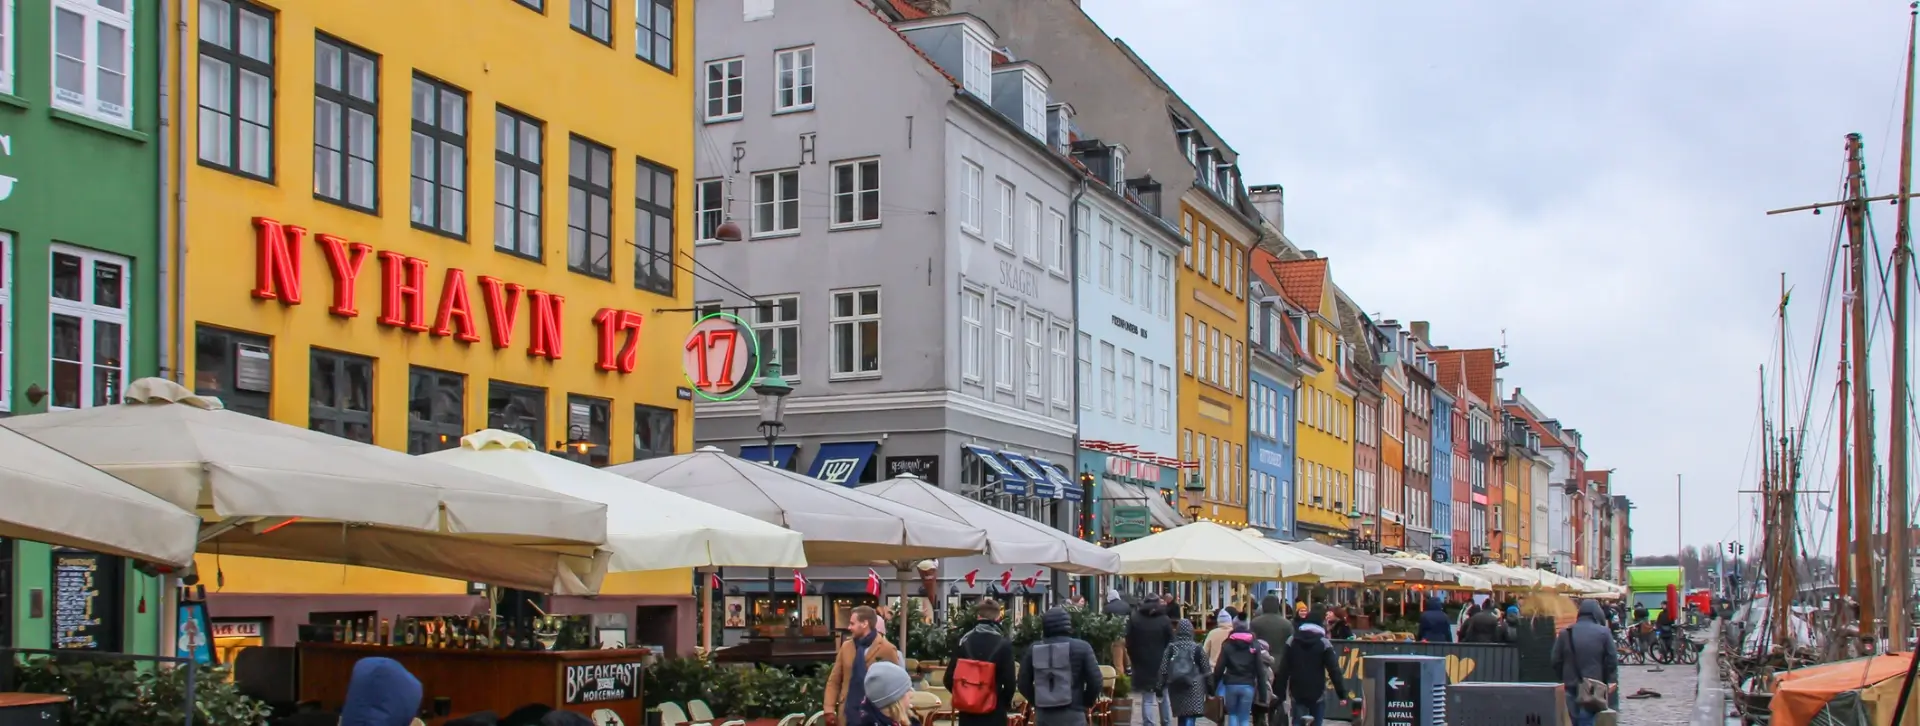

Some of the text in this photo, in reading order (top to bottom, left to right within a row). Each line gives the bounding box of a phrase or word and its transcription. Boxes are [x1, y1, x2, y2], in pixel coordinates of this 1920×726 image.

[251, 216, 644, 374] NYHAVN 17
[999, 260, 1039, 299] SKAGEN
[685, 329, 739, 387] 17
[566, 663, 641, 703] BREAKFAST
[1387, 711, 1413, 719] AVFALL
